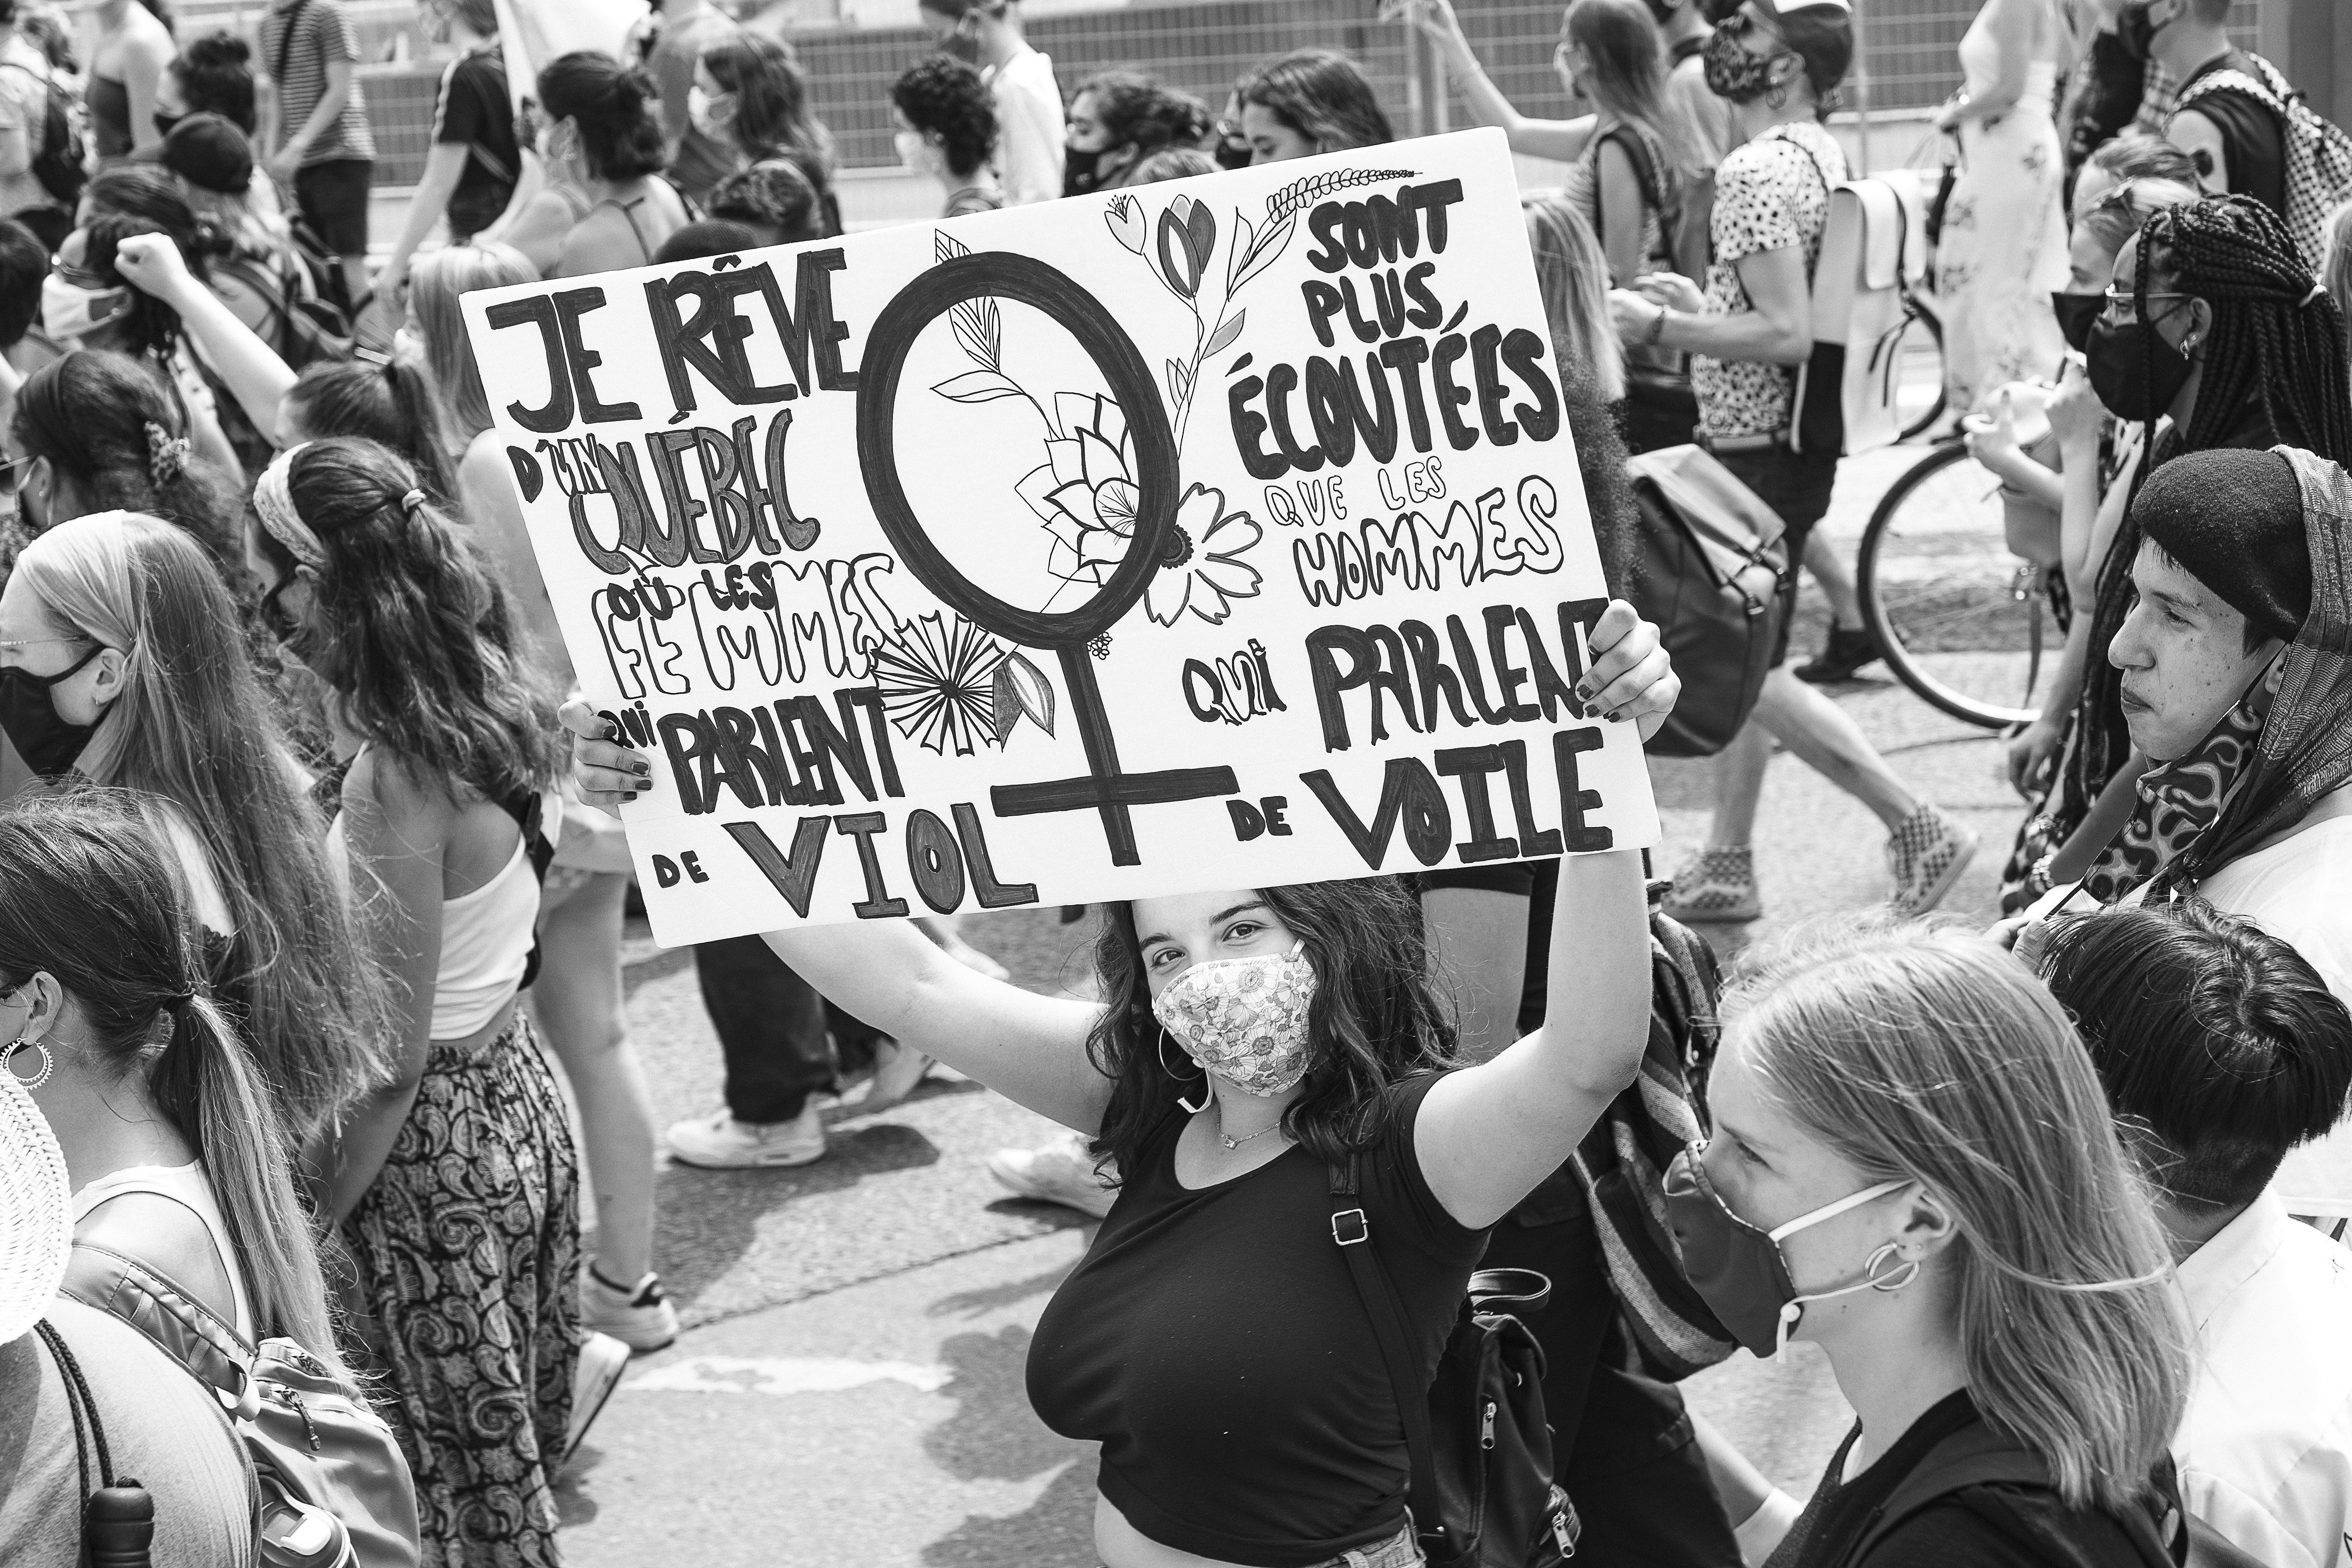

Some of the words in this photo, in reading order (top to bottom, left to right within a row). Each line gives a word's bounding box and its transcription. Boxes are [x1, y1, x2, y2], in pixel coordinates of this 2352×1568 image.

[1307, 178, 1464, 274] SONT
[486, 287, 643, 433] JE
[643, 247, 859, 411] RÊVE
[1301, 261, 1443, 348] PLUS
[1225, 300, 1560, 480] ÉCOUTÉES
[506, 433, 610, 503] D'UN
[568, 408, 820, 575] QUÉBEC
[1264, 475, 1347, 527] QUE
[1377, 456, 1446, 511] LES
[1292, 475, 1564, 607] HOMMES
[592, 553, 898, 699] FEMMES
[606, 574, 673, 621] OÙ
[701, 561, 775, 611] LES
[657, 687, 905, 815] PARLENT
[1225, 796, 1293, 842] DE
[1299, 726, 1613, 871] VOILE
[651, 850, 710, 888] DE
[721, 802, 1038, 919] VIOL
